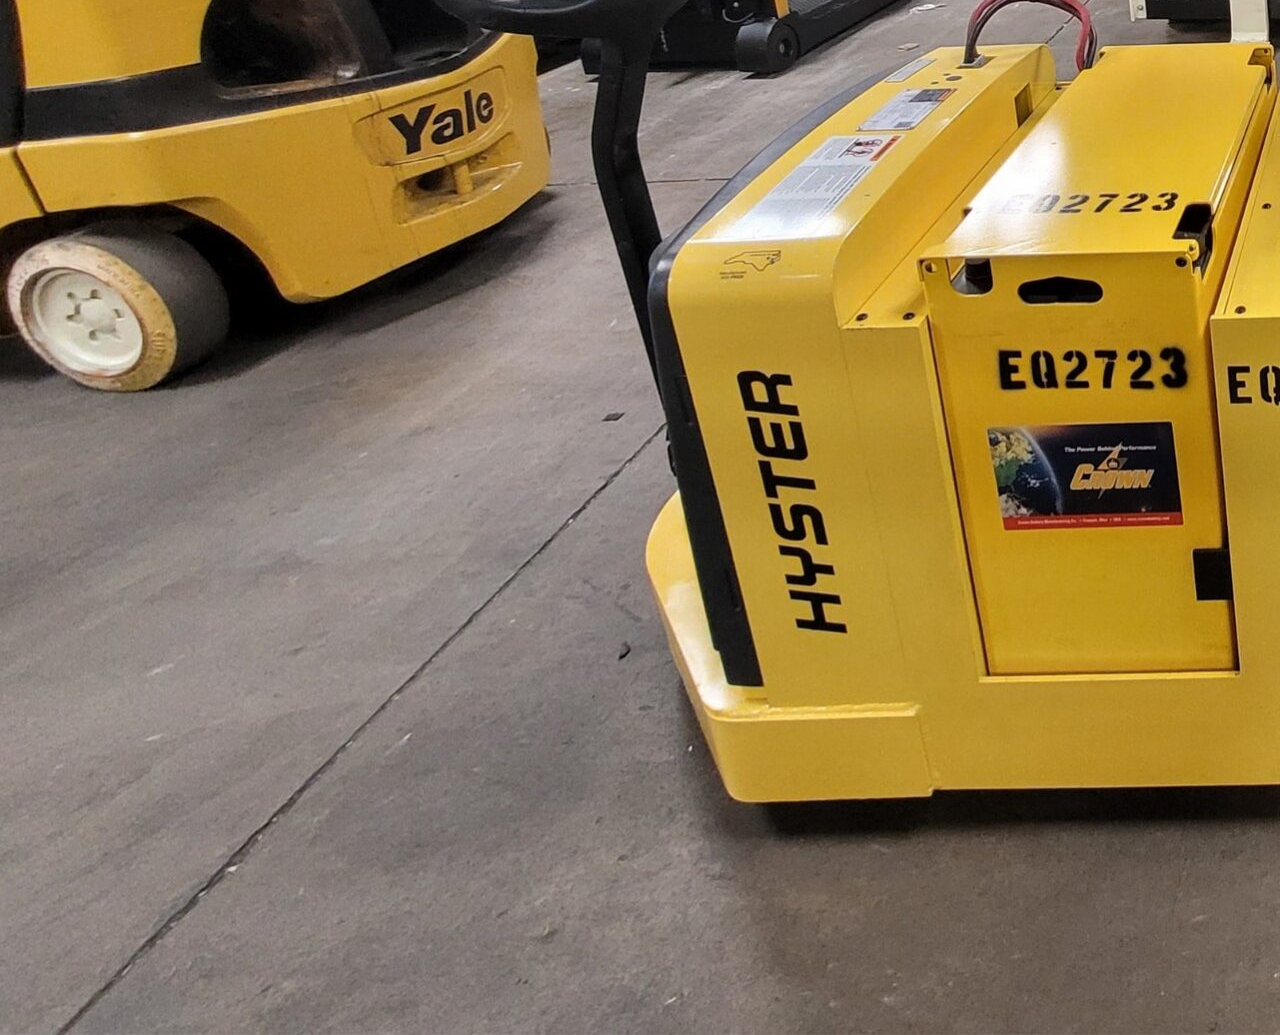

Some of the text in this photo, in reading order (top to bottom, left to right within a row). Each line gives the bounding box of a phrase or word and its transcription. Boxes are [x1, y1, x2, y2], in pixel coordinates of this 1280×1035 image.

[388, 89, 494, 155] Yale
[999, 192, 1178, 213] EQ2723
[998, 346, 1189, 390] EQ2723
[736, 370, 848, 634] HYSTER
